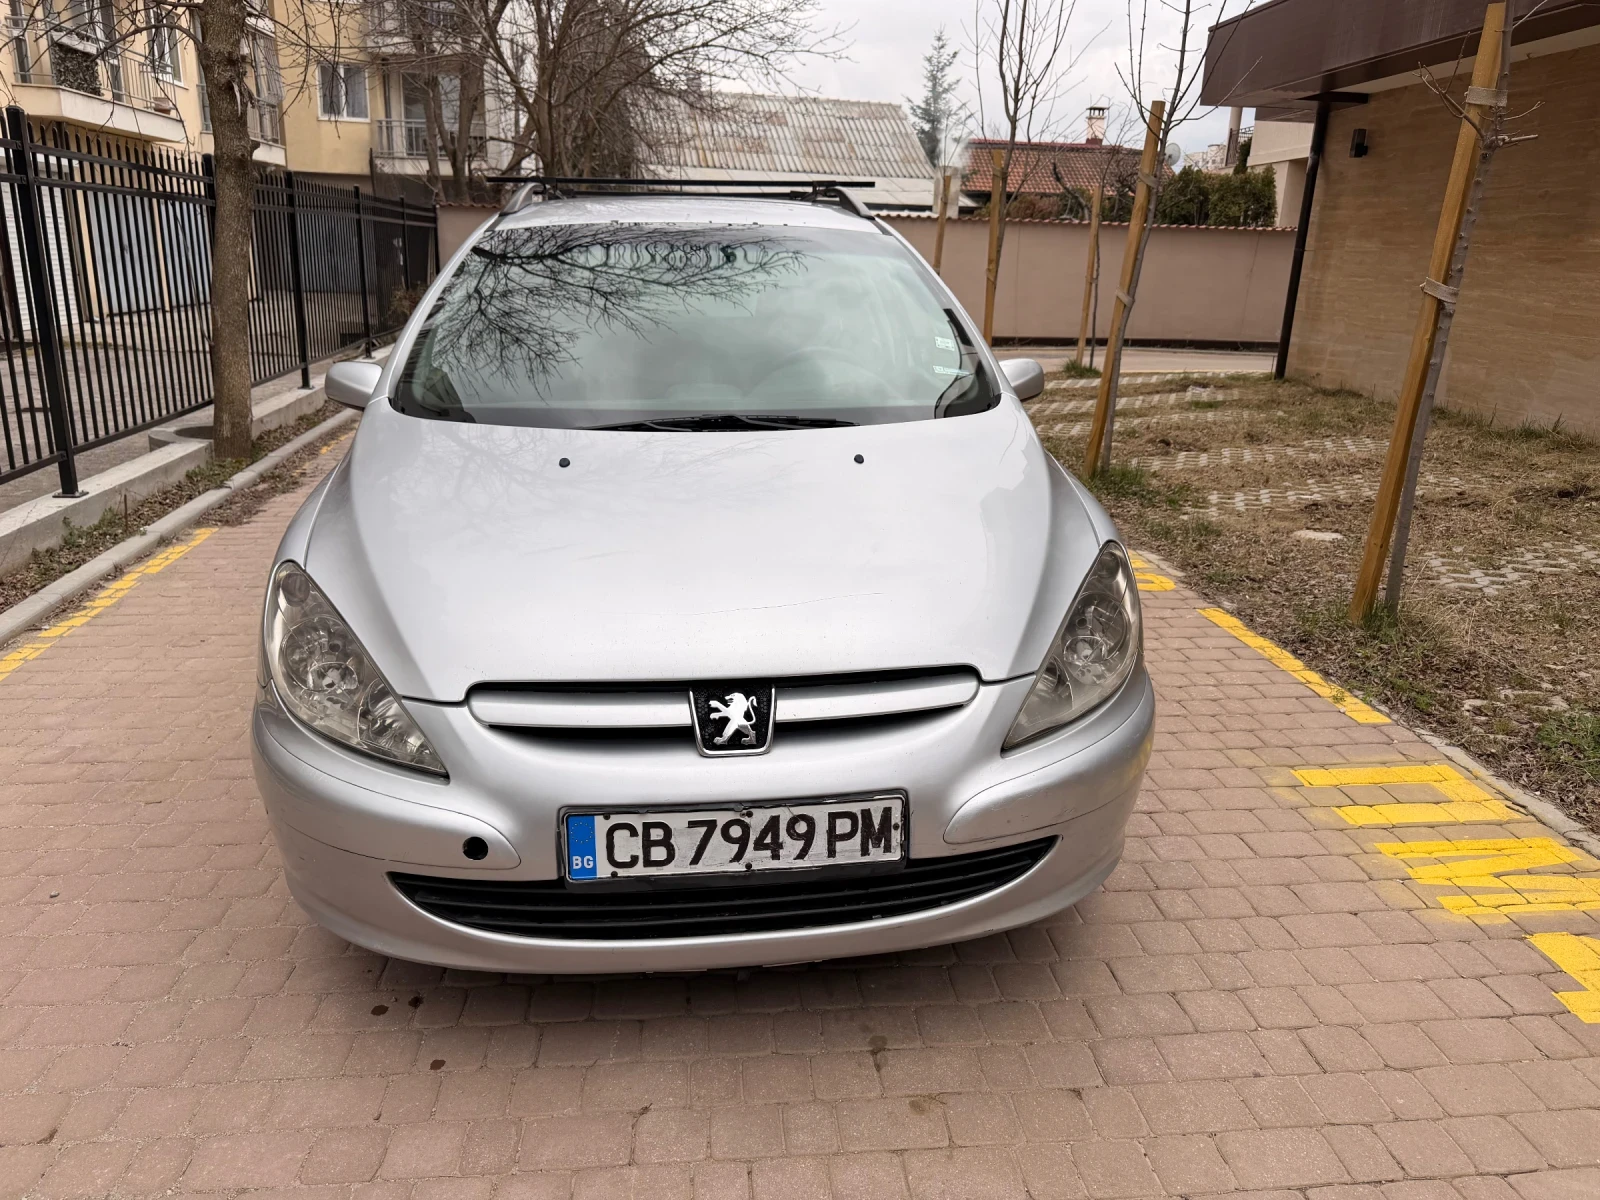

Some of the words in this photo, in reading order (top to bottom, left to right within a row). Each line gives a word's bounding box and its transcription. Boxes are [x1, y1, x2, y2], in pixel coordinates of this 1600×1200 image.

[605, 821, 676, 869] CB
[687, 812, 817, 867] 7949
[826, 806, 893, 859] PM
[572, 855, 594, 870] BG
